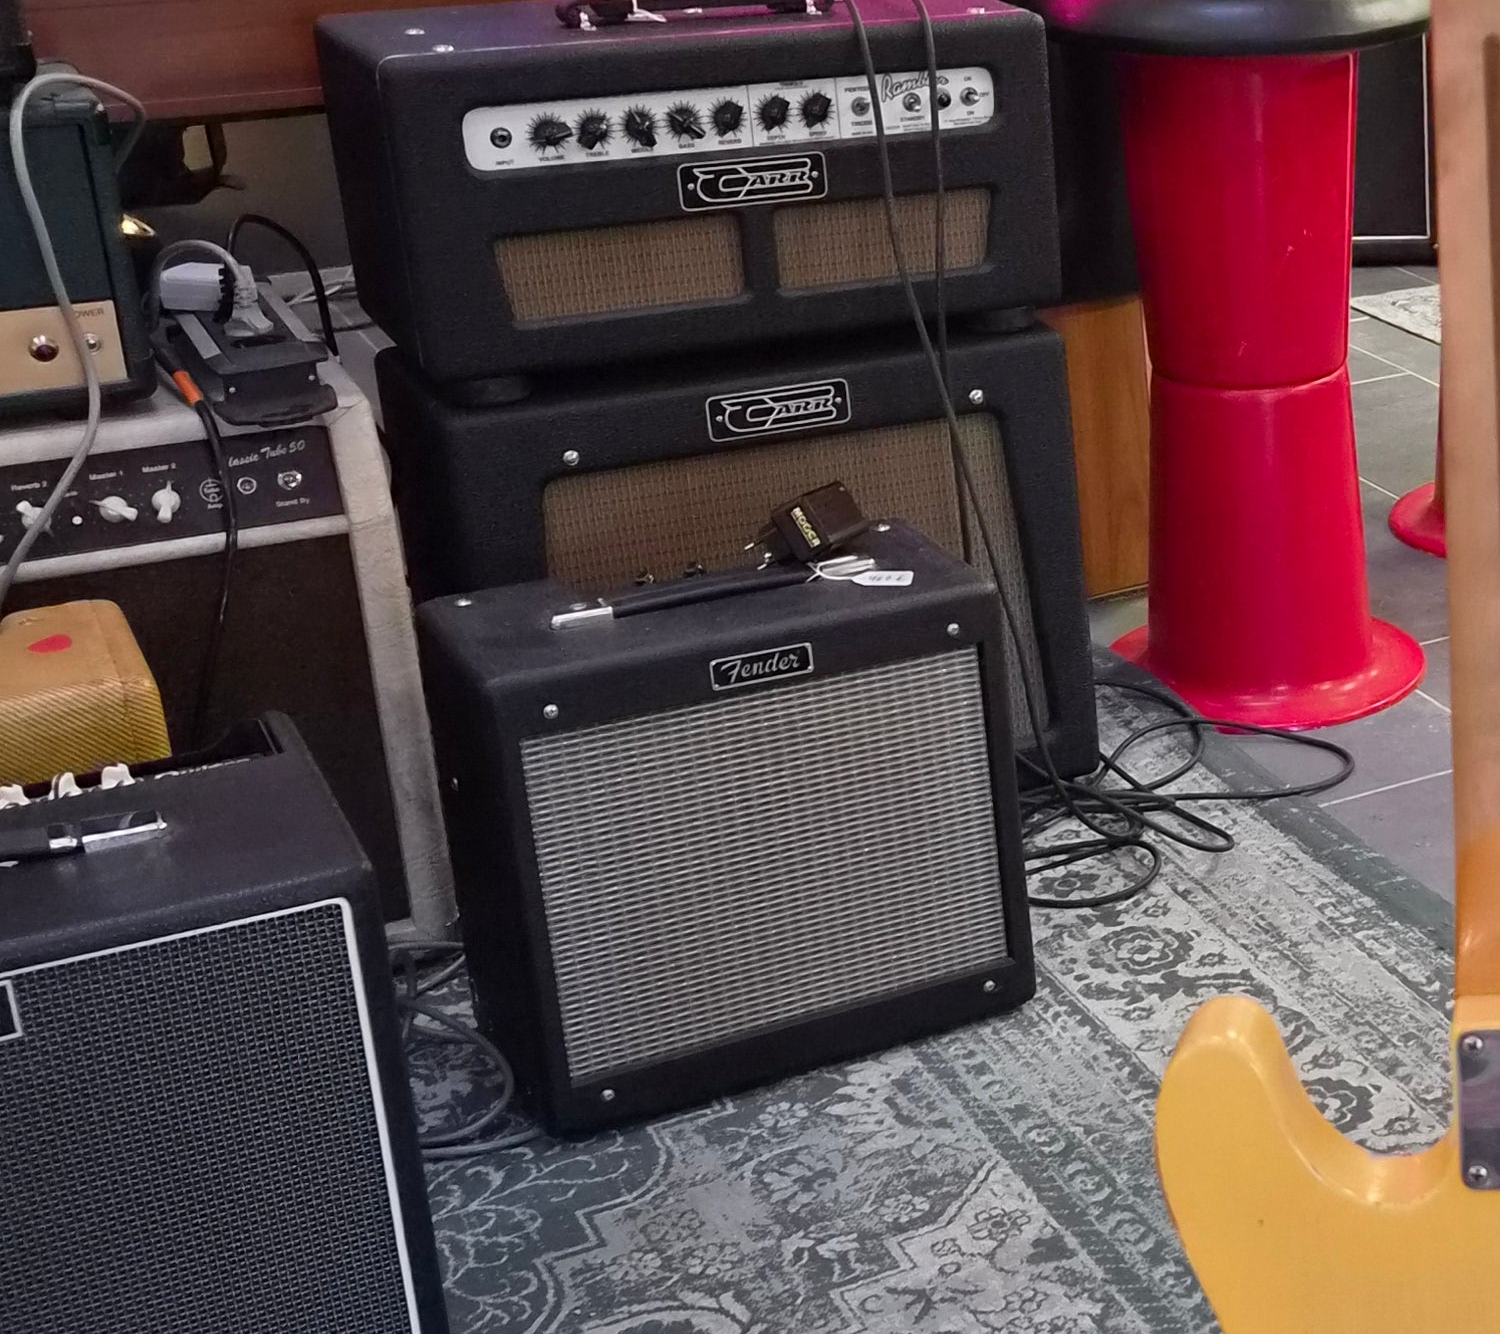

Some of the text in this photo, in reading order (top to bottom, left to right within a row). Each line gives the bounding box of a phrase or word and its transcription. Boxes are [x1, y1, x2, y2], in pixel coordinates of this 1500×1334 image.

[73, 307, 105, 318] OWER
[288, 439, 306, 454] 50
[720, 652, 800, 684] Fender
